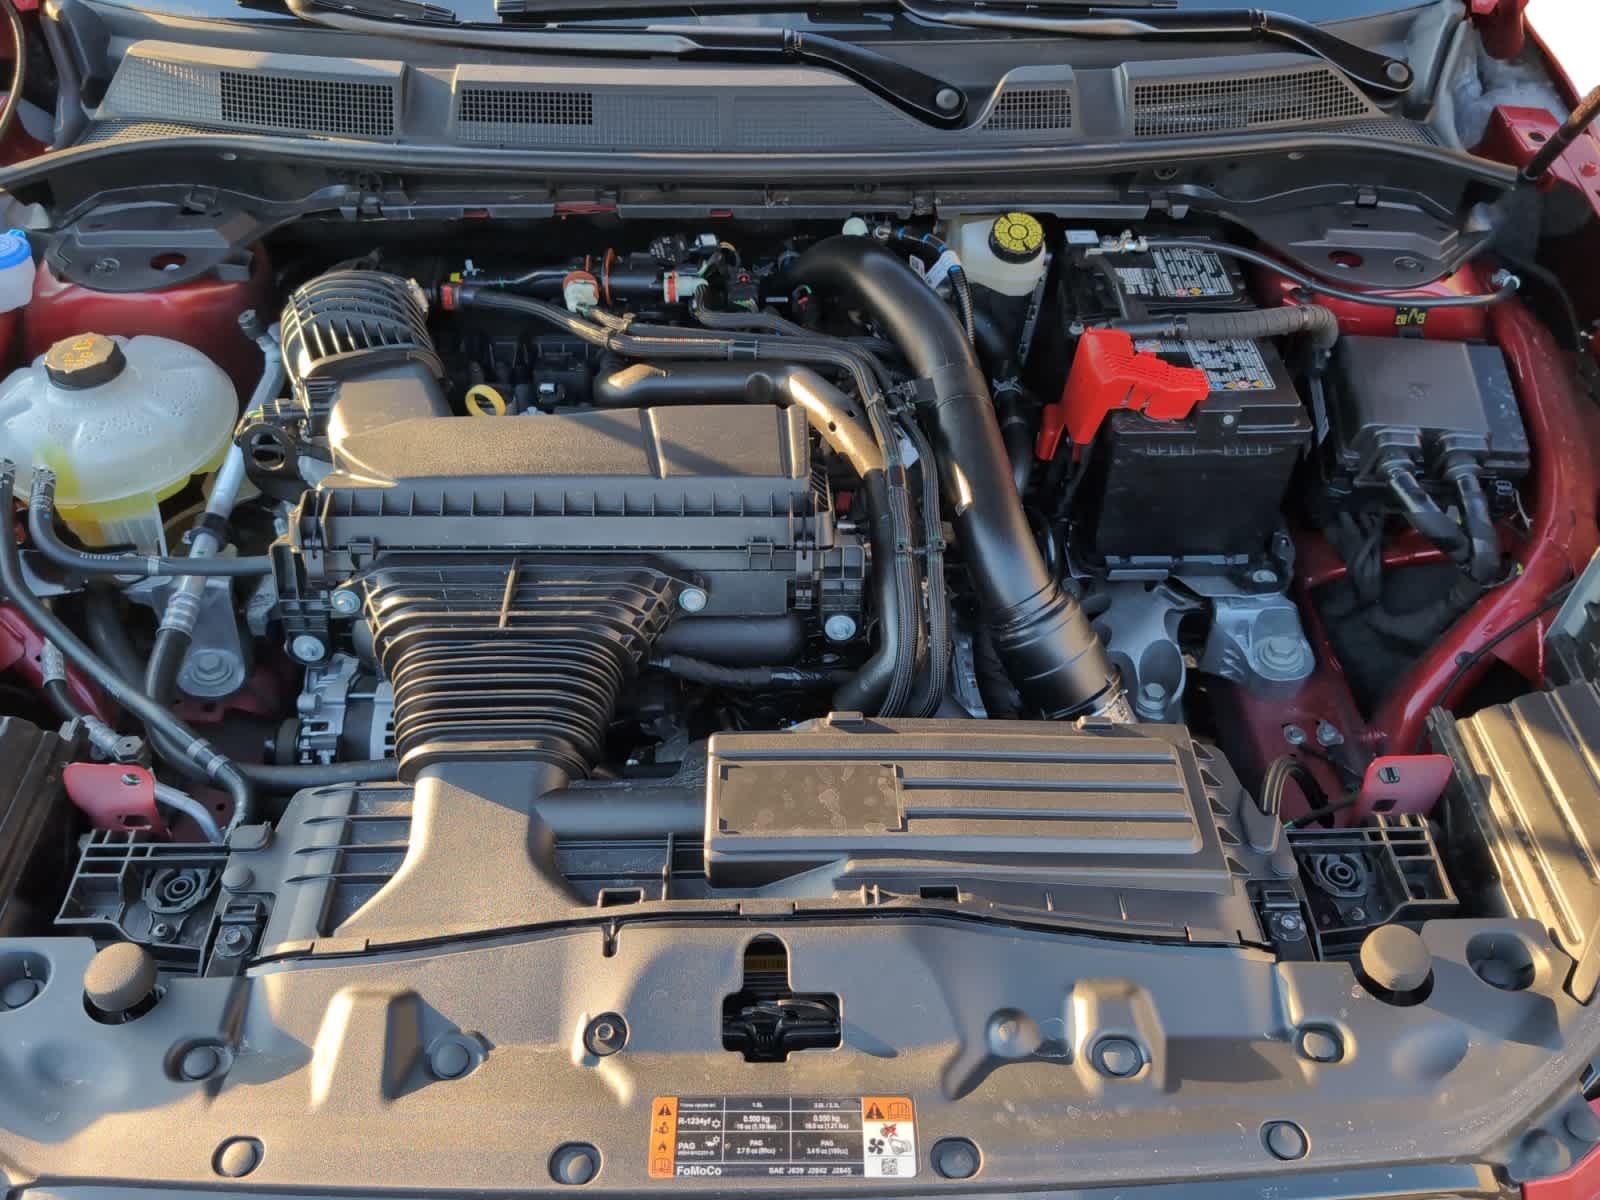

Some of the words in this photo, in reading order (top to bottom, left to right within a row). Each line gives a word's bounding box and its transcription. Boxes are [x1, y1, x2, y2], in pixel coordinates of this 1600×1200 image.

[678, 1117, 711, 1126] R-1234yf
[678, 1142, 696, 1150] PAG
[677, 1165, 722, 1176] FoMoCo
